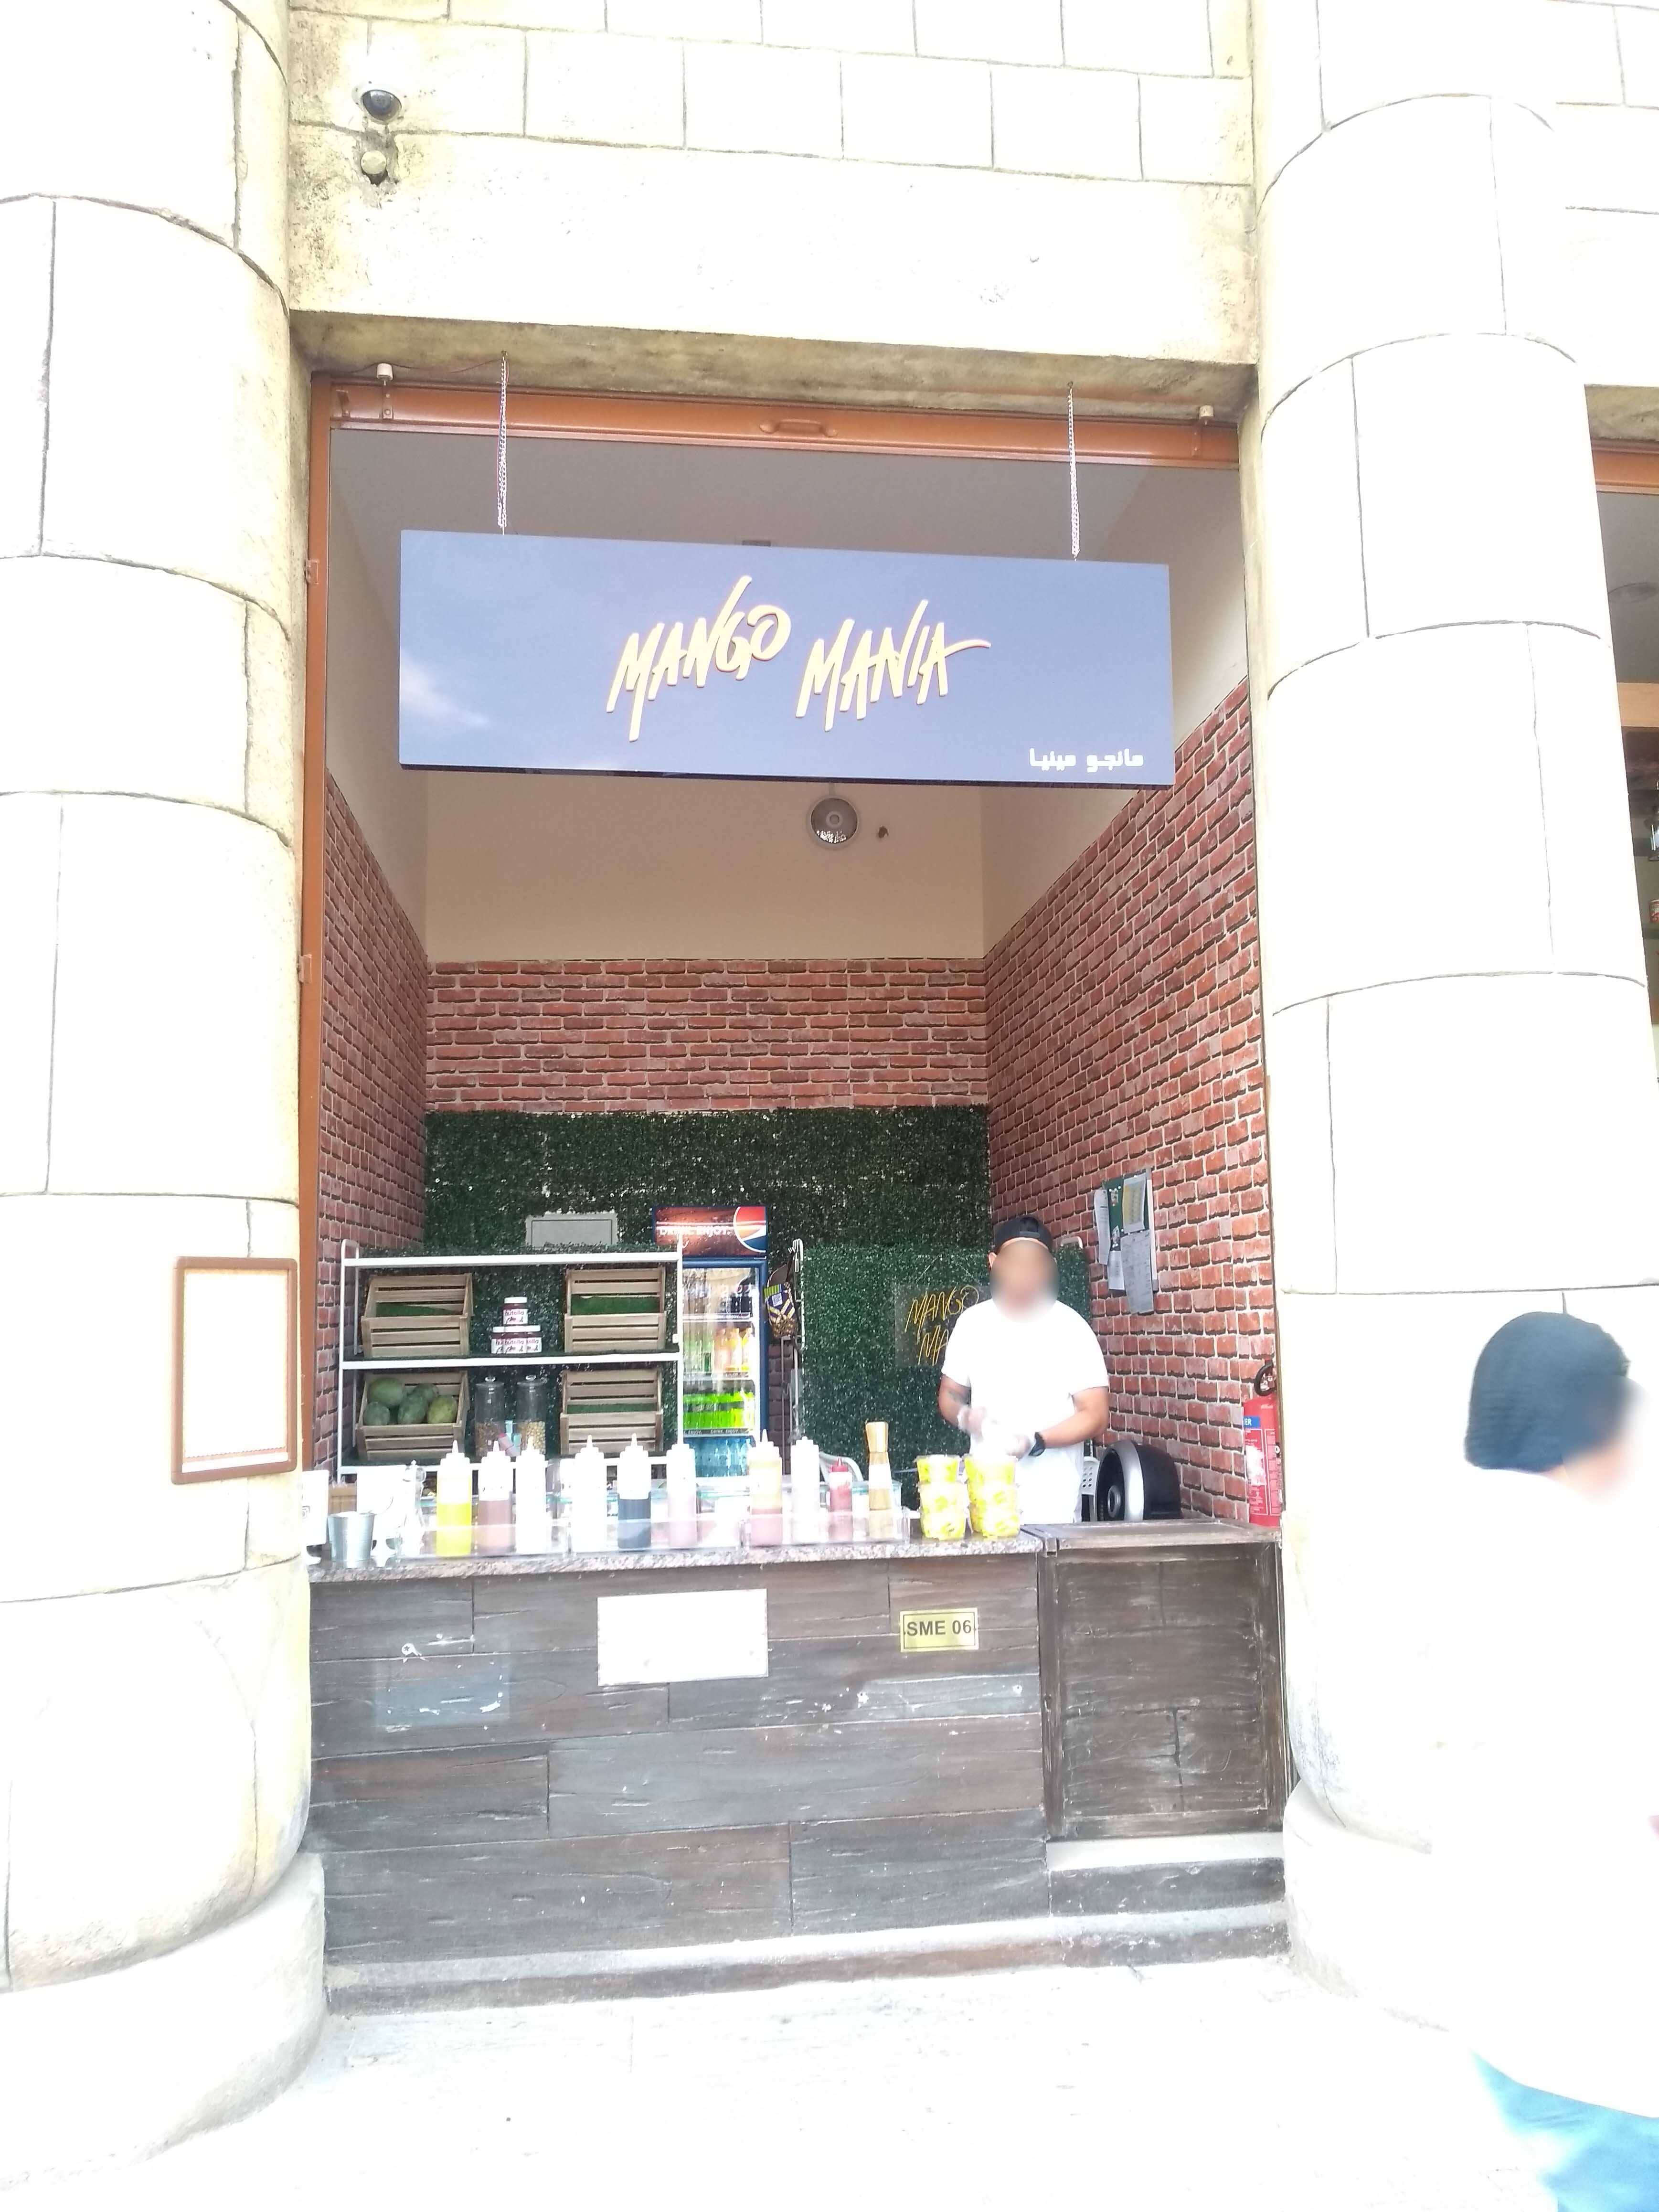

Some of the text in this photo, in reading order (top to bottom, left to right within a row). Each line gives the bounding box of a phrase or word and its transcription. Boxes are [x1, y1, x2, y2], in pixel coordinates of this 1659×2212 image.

[606, 575, 991, 742] MANGO MANIA
[1029, 748, 1144, 773] مانجو مينيا
[904, 1285, 979, 1345] MANGO
[918, 1325, 949, 1366] MA
[906, 1619, 972, 1637] SME 06
